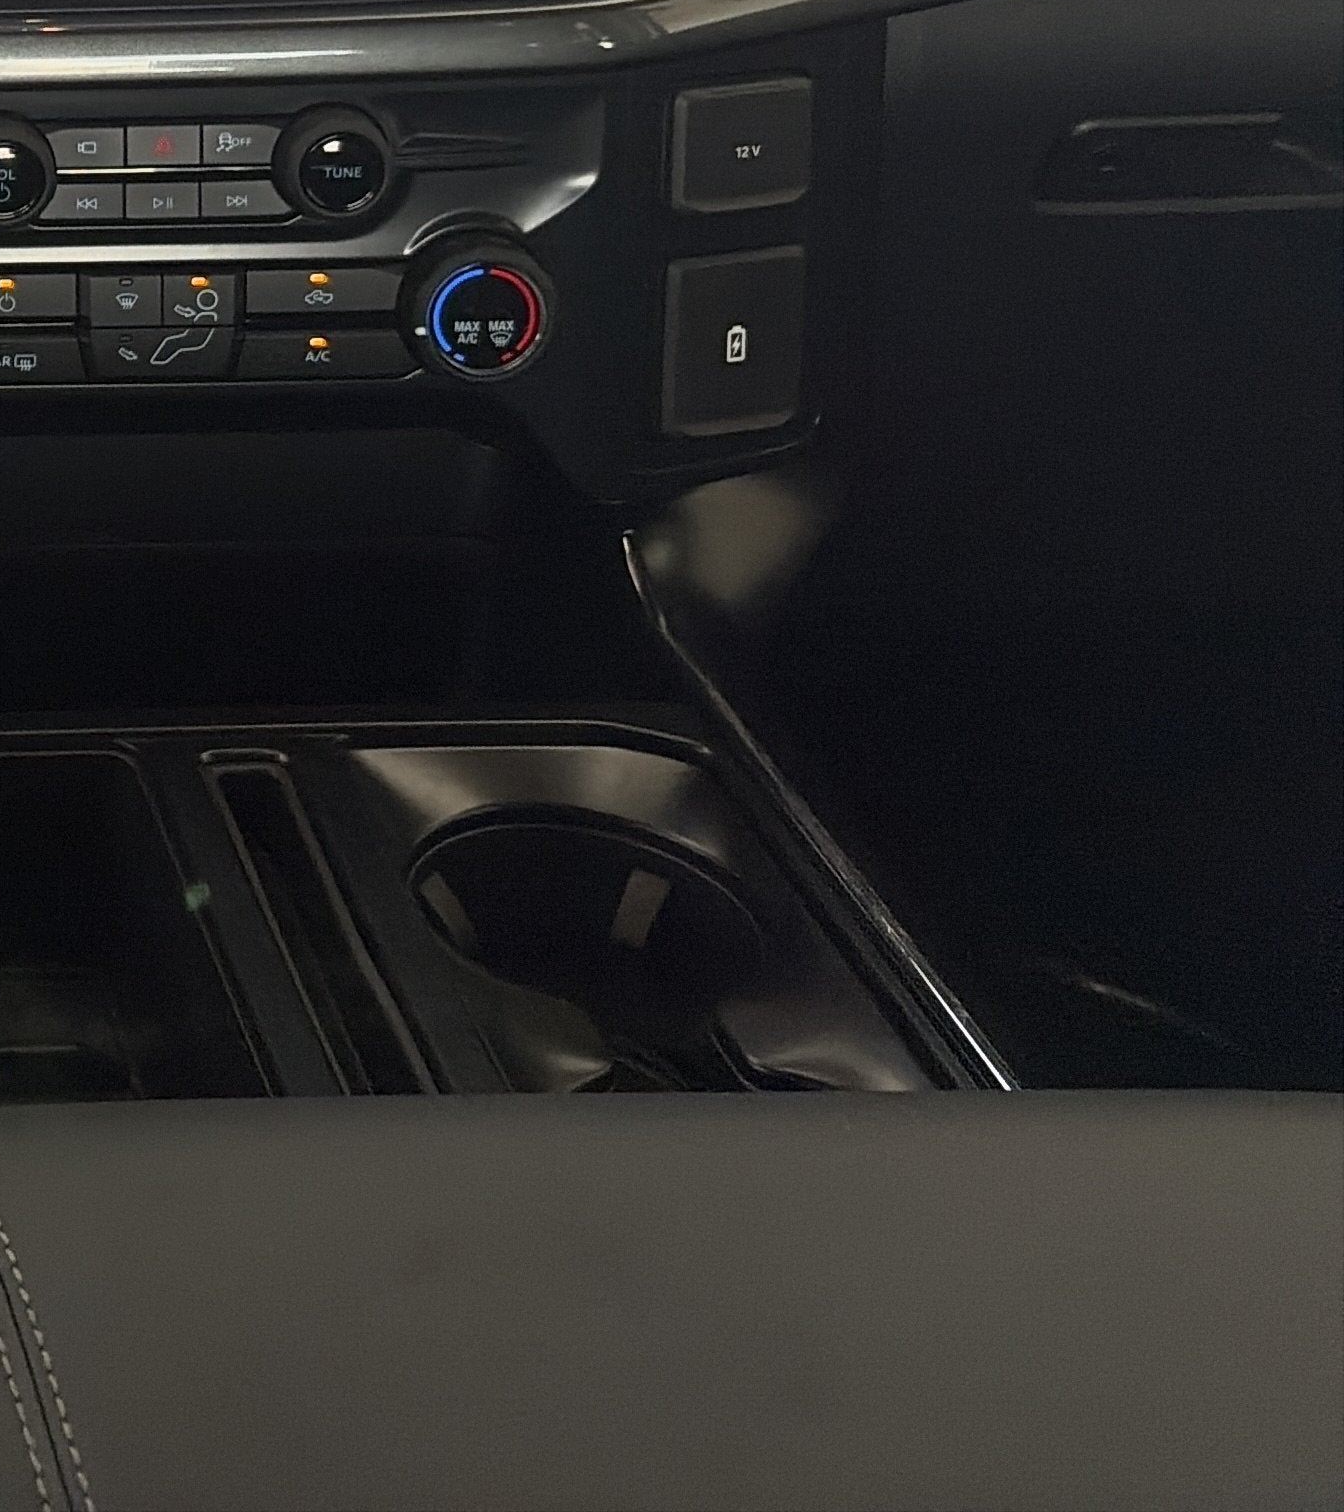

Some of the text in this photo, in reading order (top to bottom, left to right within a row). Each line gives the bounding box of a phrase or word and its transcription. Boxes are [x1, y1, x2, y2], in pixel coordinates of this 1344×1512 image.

[231, 137, 253, 148] OFF
[735, 144, 762, 159] 12 V
[323, 166, 363, 180] TUNE
[454, 319, 481, 333] MAX
[488, 319, 515, 333] MAX
[456, 333, 479, 346] A/C
[305, 350, 332, 363] A/C
